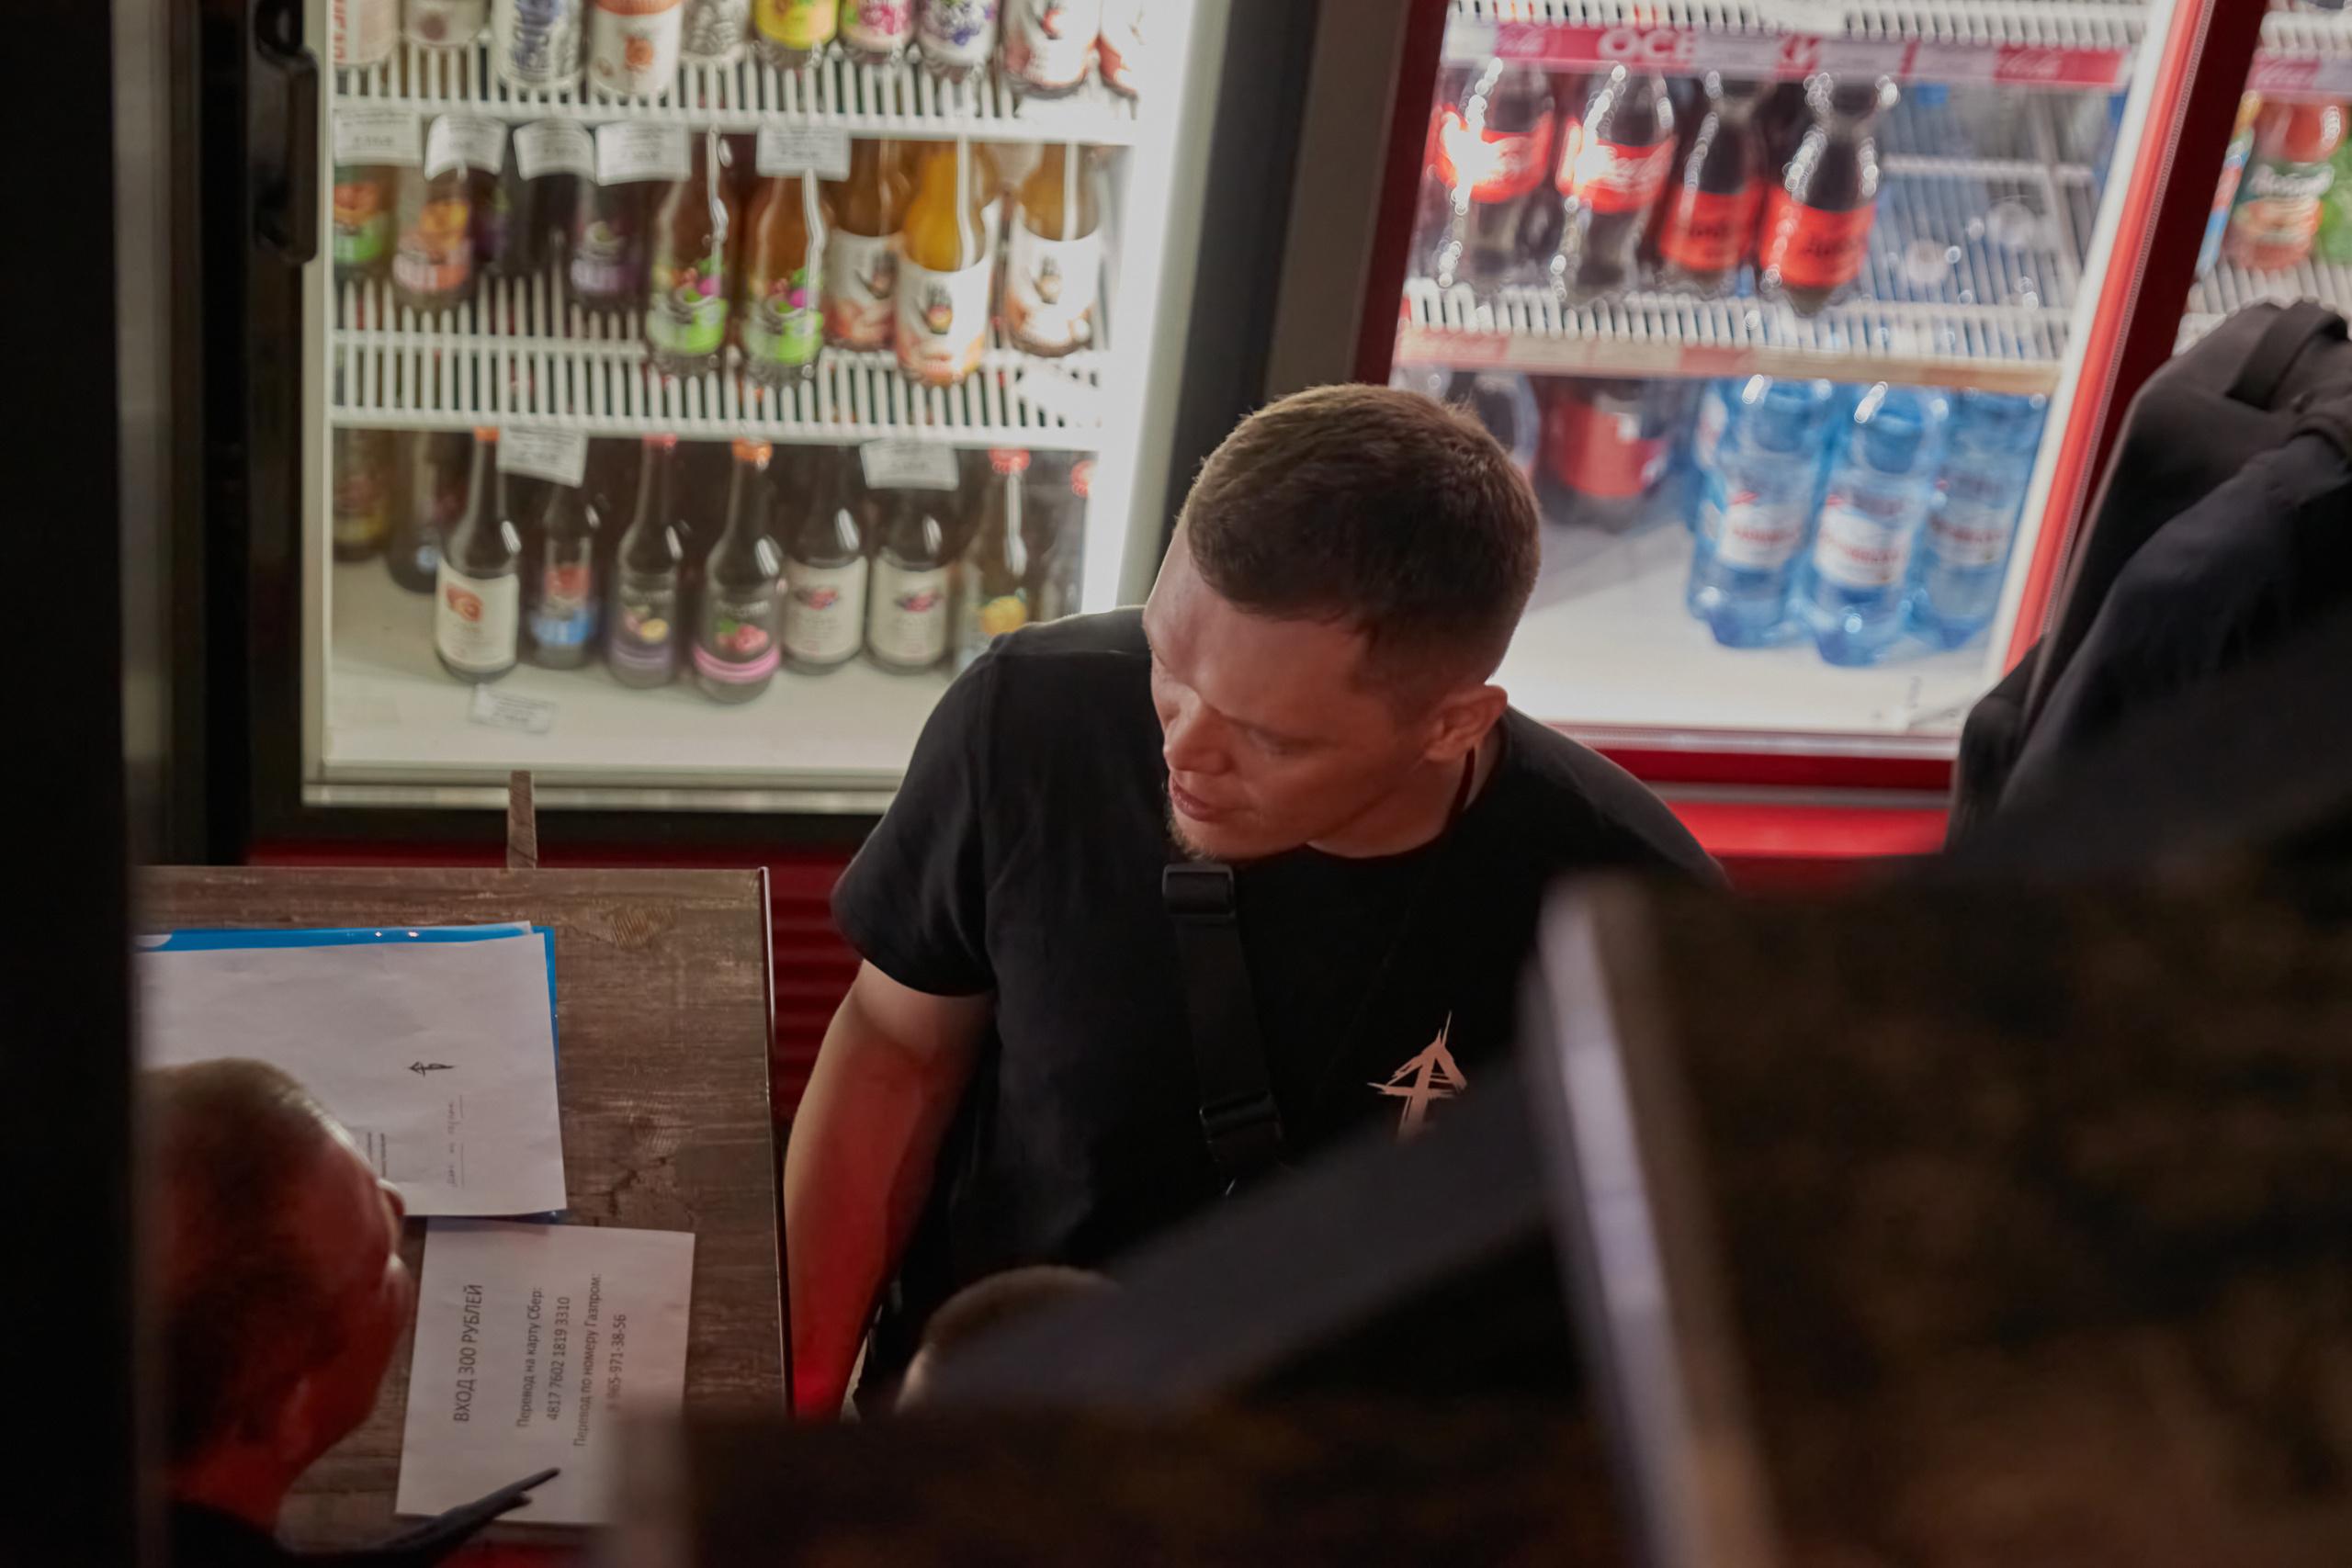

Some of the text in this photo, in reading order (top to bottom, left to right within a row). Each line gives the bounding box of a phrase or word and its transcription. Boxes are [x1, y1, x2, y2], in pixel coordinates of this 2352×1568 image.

[453, 1284, 483, 1423] ВХОД 300 РУБЛЕЙ
[516, 1287, 545, 1428] Перевод на карту Сбер:
[547, 1296, 571, 1422] 4817 7602 1819 3310
[573, 1273, 603, 1448] Перевод по номеру Газпром:
